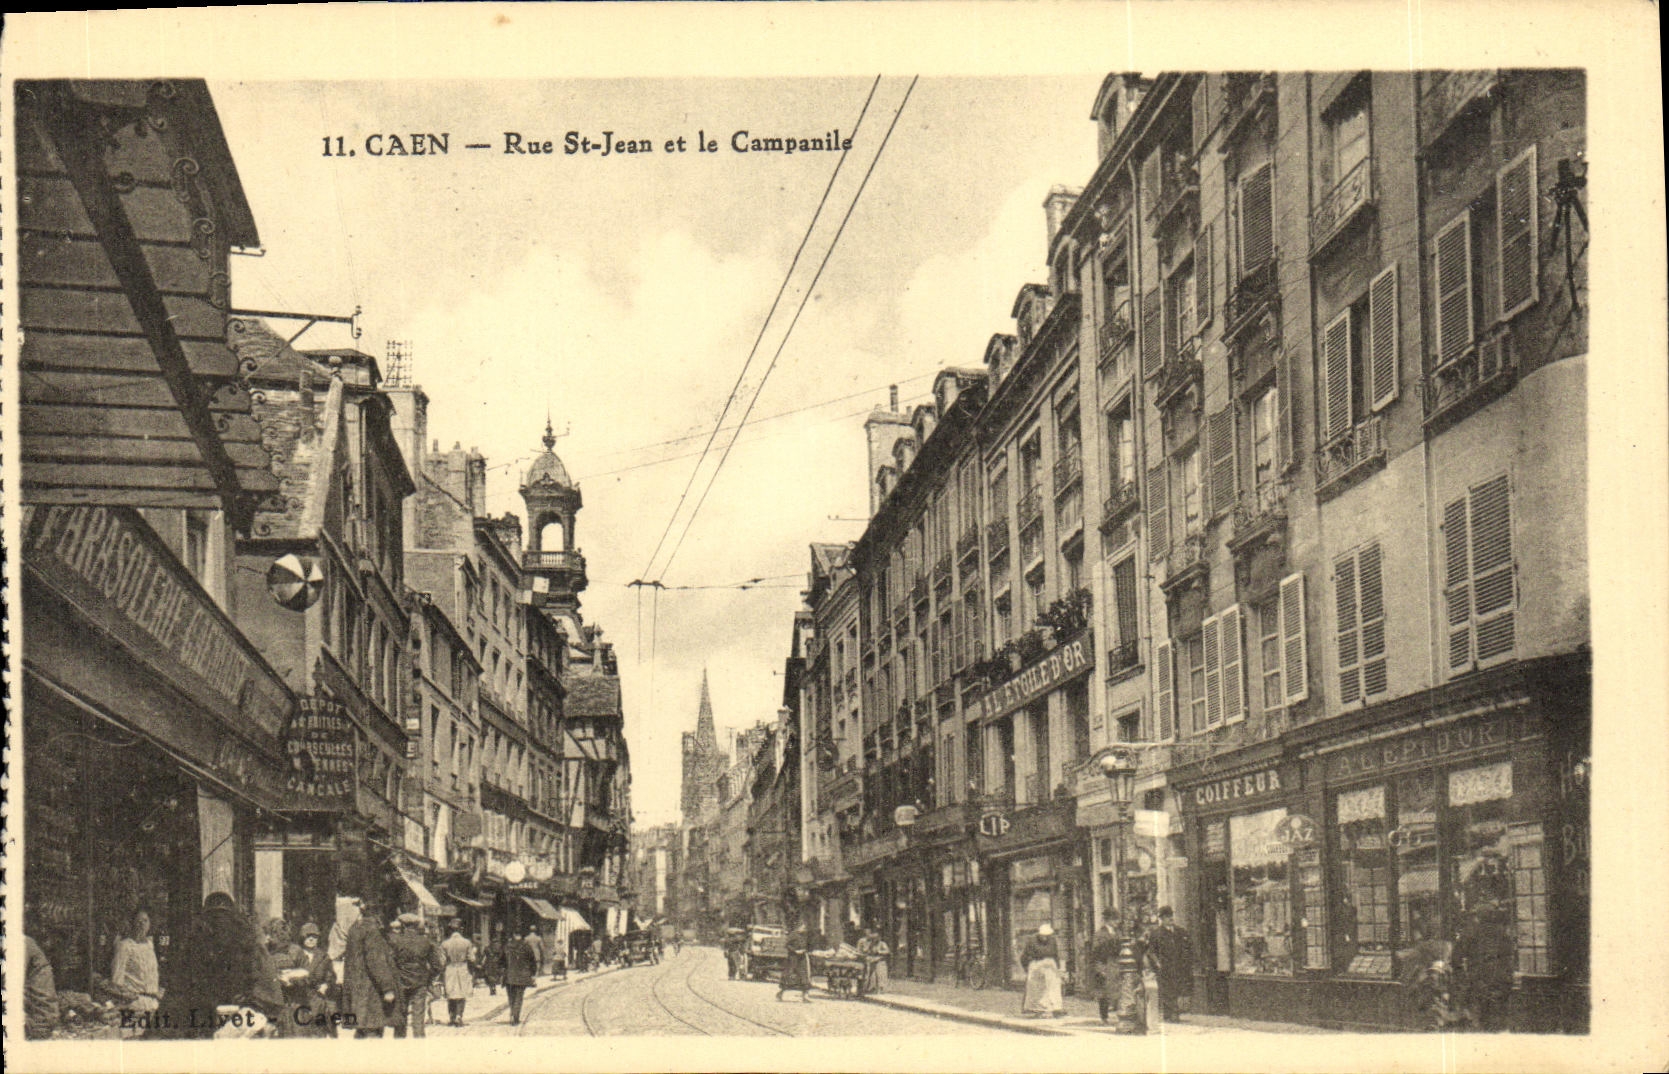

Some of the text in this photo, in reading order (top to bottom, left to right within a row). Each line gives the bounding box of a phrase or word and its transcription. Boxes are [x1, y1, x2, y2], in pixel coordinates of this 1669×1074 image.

[287, 776, 351, 797] CANCALE
[1195, 769, 1282, 806] COIFFEUR
[979, 811, 1011, 837] LIP
[1280, 827, 1316, 844] JAZ
